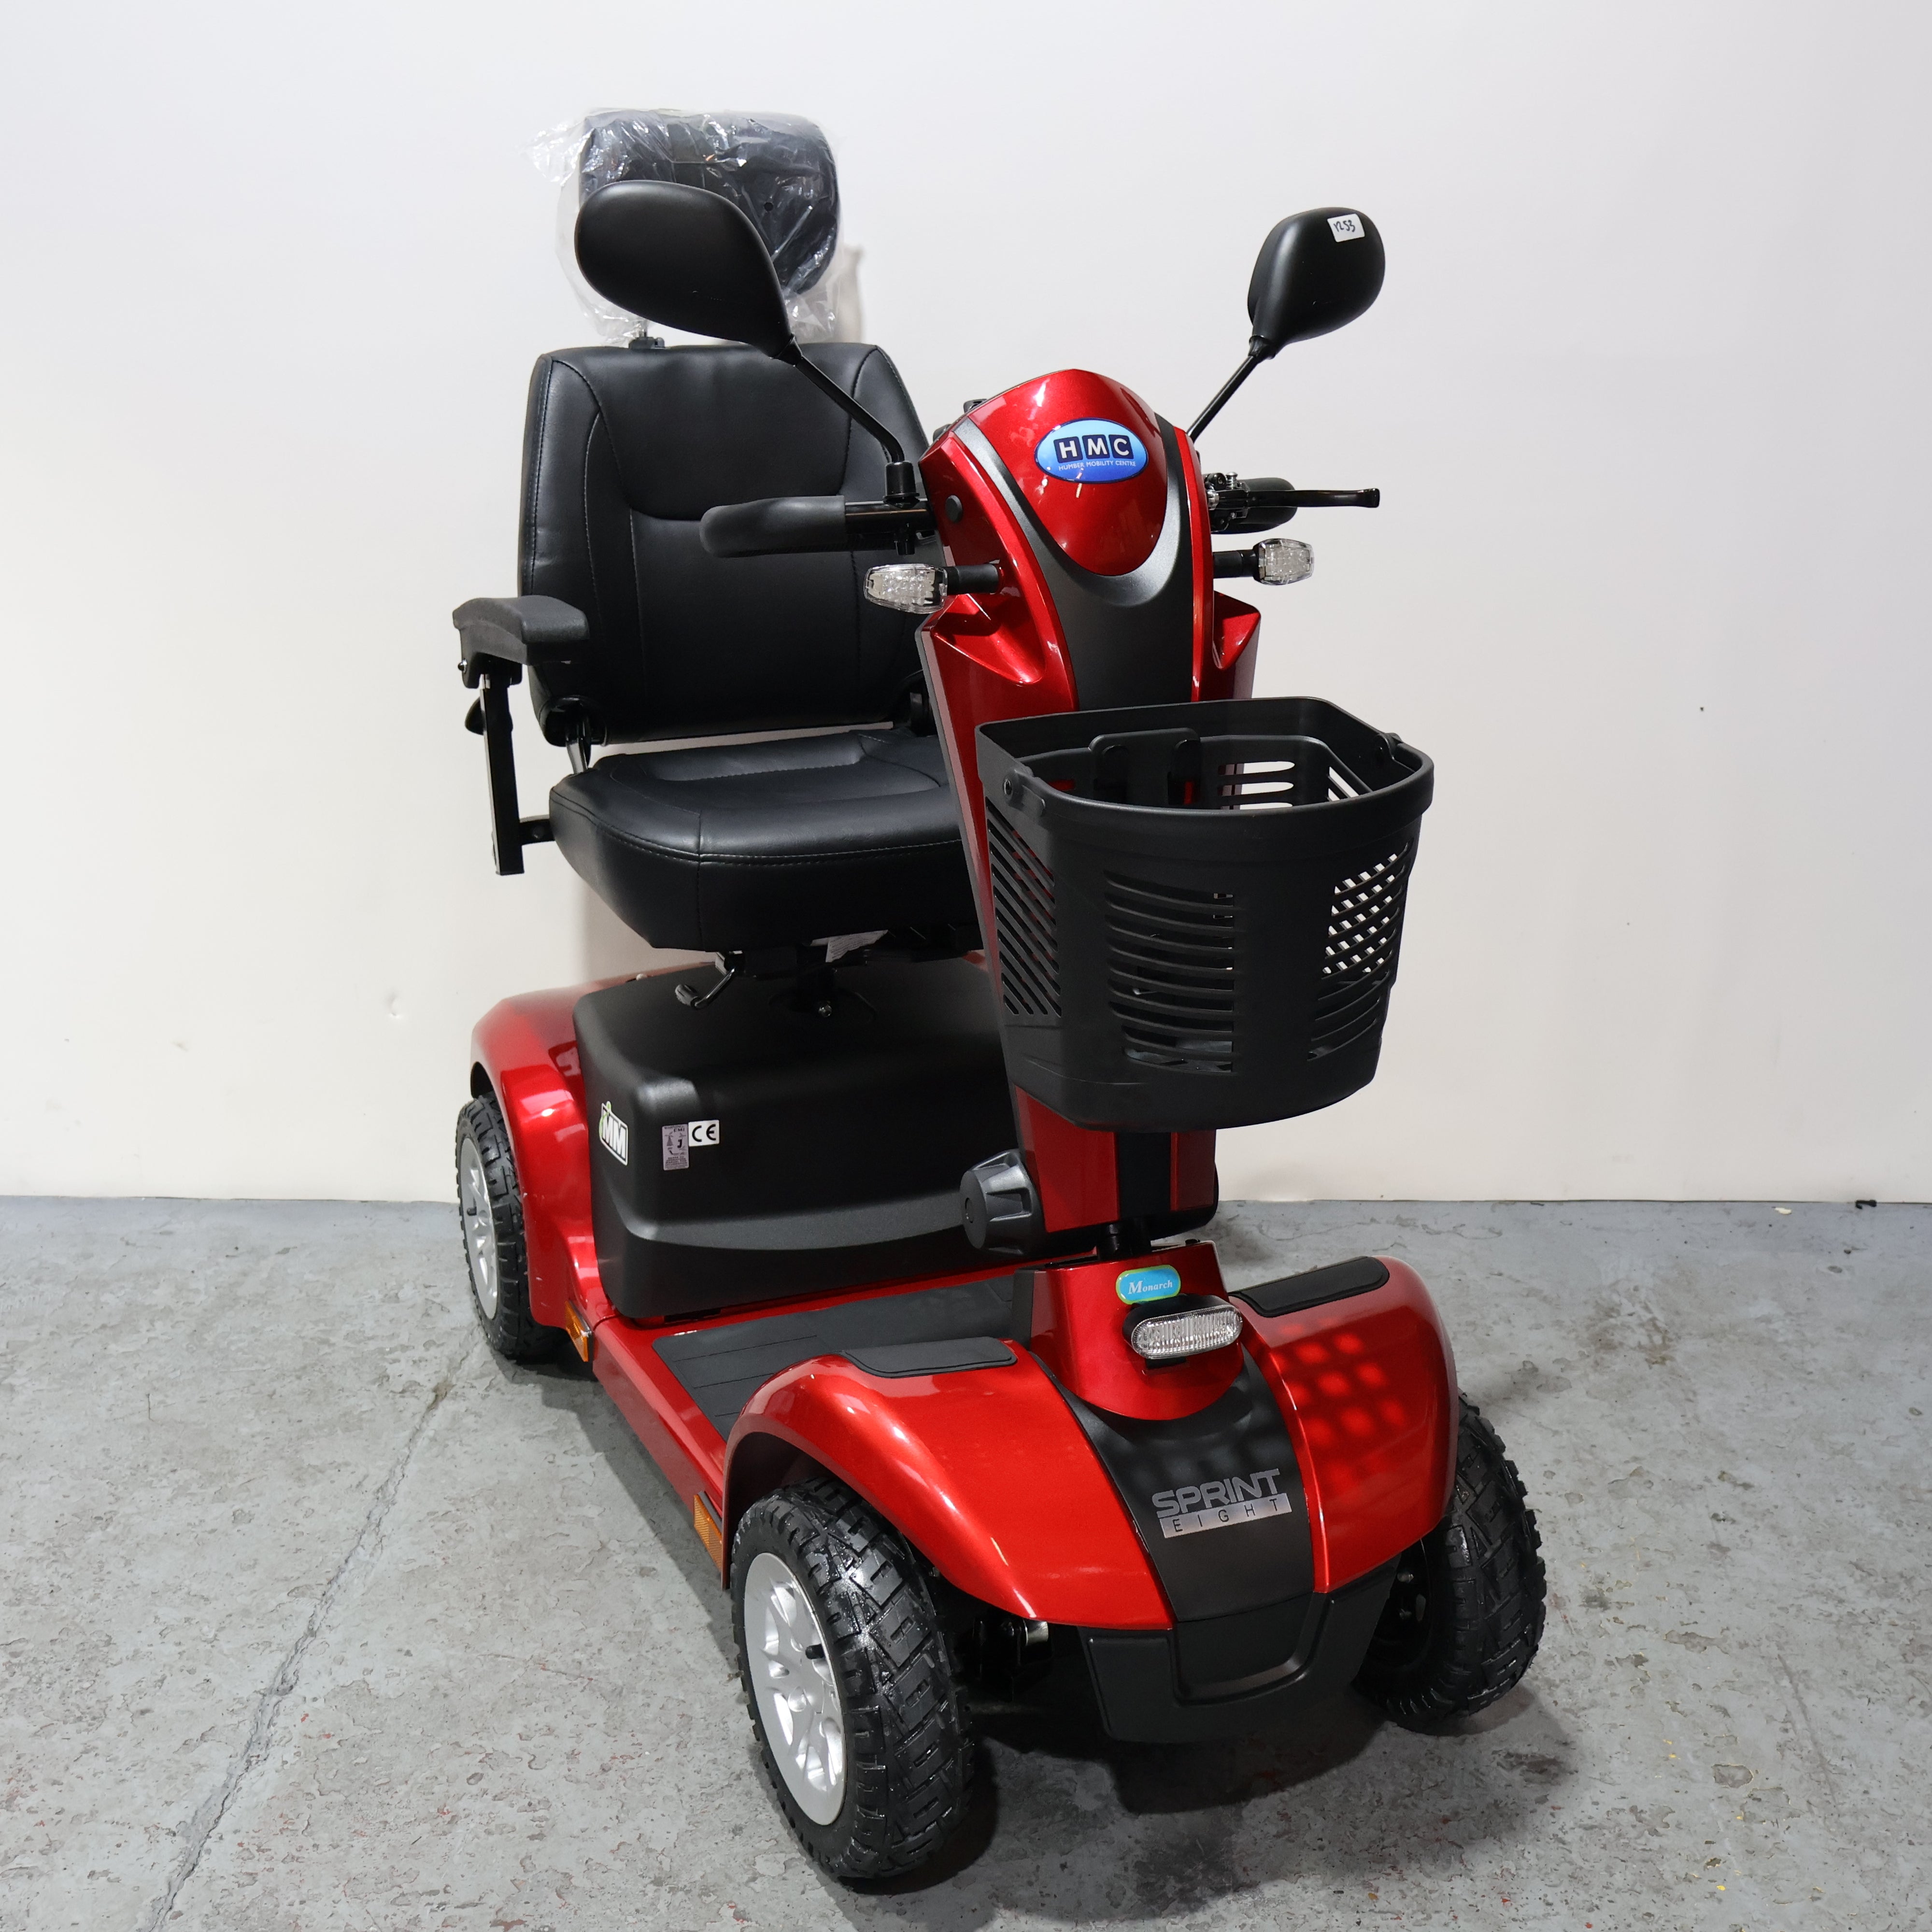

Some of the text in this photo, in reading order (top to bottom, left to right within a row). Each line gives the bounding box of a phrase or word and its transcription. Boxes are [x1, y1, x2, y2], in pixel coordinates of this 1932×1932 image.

[1058, 438, 1130, 459] HMC
[1058, 462, 1085, 471] HUMBER
[692, 1123, 716, 1142] CE
[1128, 1280, 1173, 1294] Monarch
[1152, 1468, 1280, 1518] SPRINT
[1172, 1498, 1278, 1533] EIGHT
